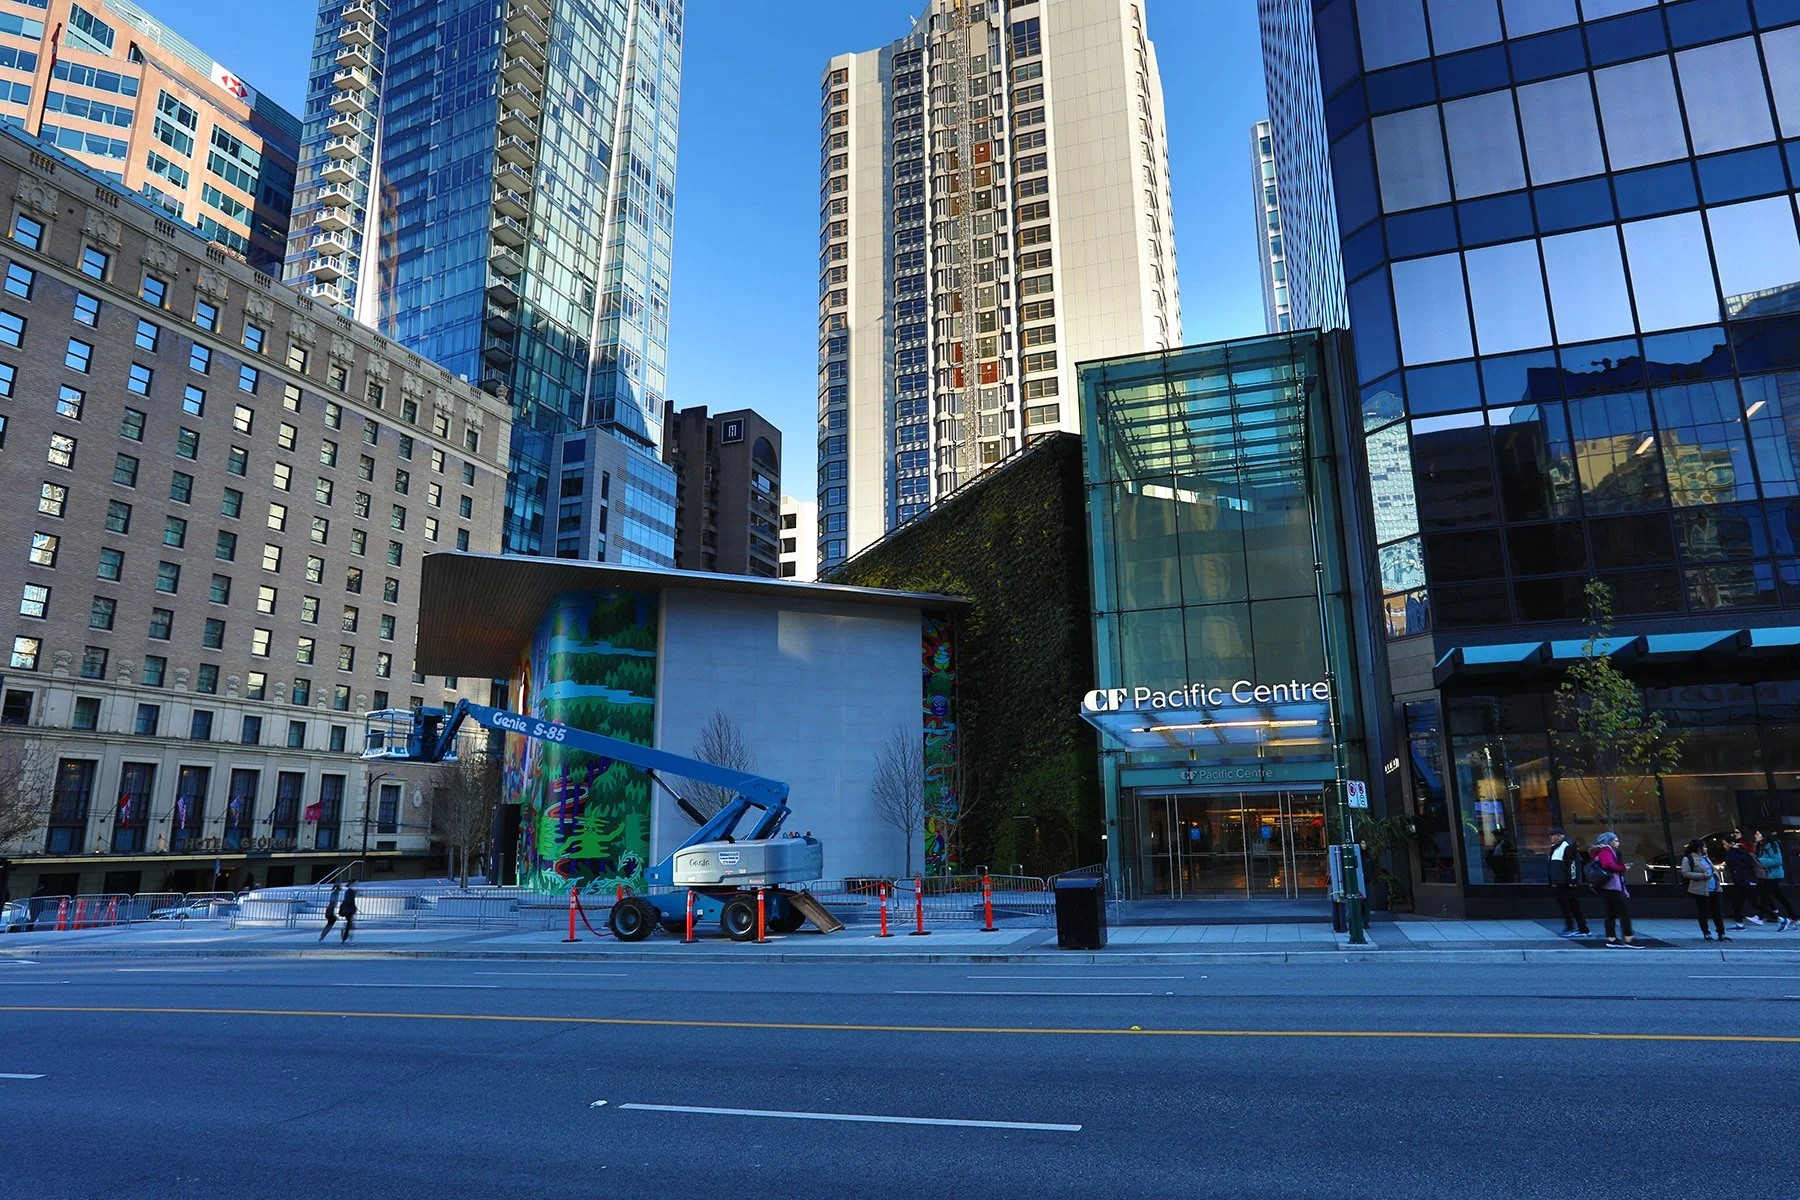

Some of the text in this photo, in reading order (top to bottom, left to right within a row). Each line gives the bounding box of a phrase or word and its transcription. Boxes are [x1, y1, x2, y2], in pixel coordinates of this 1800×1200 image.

[1083, 679, 1330, 711] CF Pacific Centre
[492, 711, 567, 742] Genie S-85
[1199, 769, 1233, 779] Pacific
[1236, 768, 1273, 779] Centre
[184, 838, 298, 850] HOTEL GEORGIA
